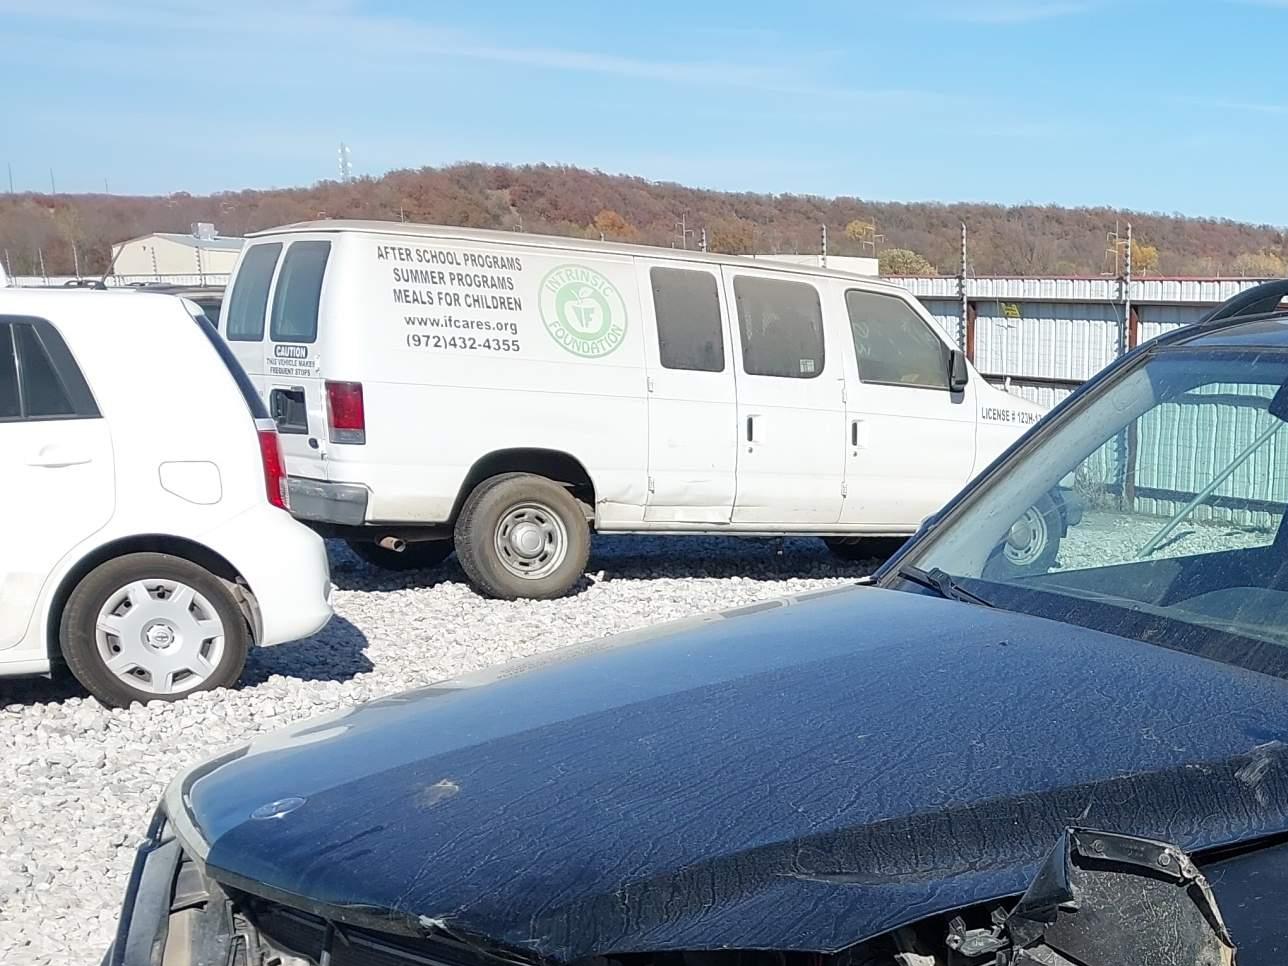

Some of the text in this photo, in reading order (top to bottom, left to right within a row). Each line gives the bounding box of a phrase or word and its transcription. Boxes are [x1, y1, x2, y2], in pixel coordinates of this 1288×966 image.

[377, 245, 522, 271] AFTER SCHOOL PROGRAMS
[393, 267, 514, 290] SUMMER PROGRAMS
[545, 268, 613, 297] INTRINSIC
[392, 288, 522, 311] MEALS FOR CHILDREN
[404, 315, 518, 335] www.ifcares.org
[406, 334, 521, 352] (972)432-4355
[549, 320, 623, 354] FOUNDATION
[275, 345, 306, 358] CAUTION
[270, 366, 311, 376] FREQUENT STOPS
[278, 358, 298, 367] VEHICLE
[981, 407, 1010, 422] LICENSE
